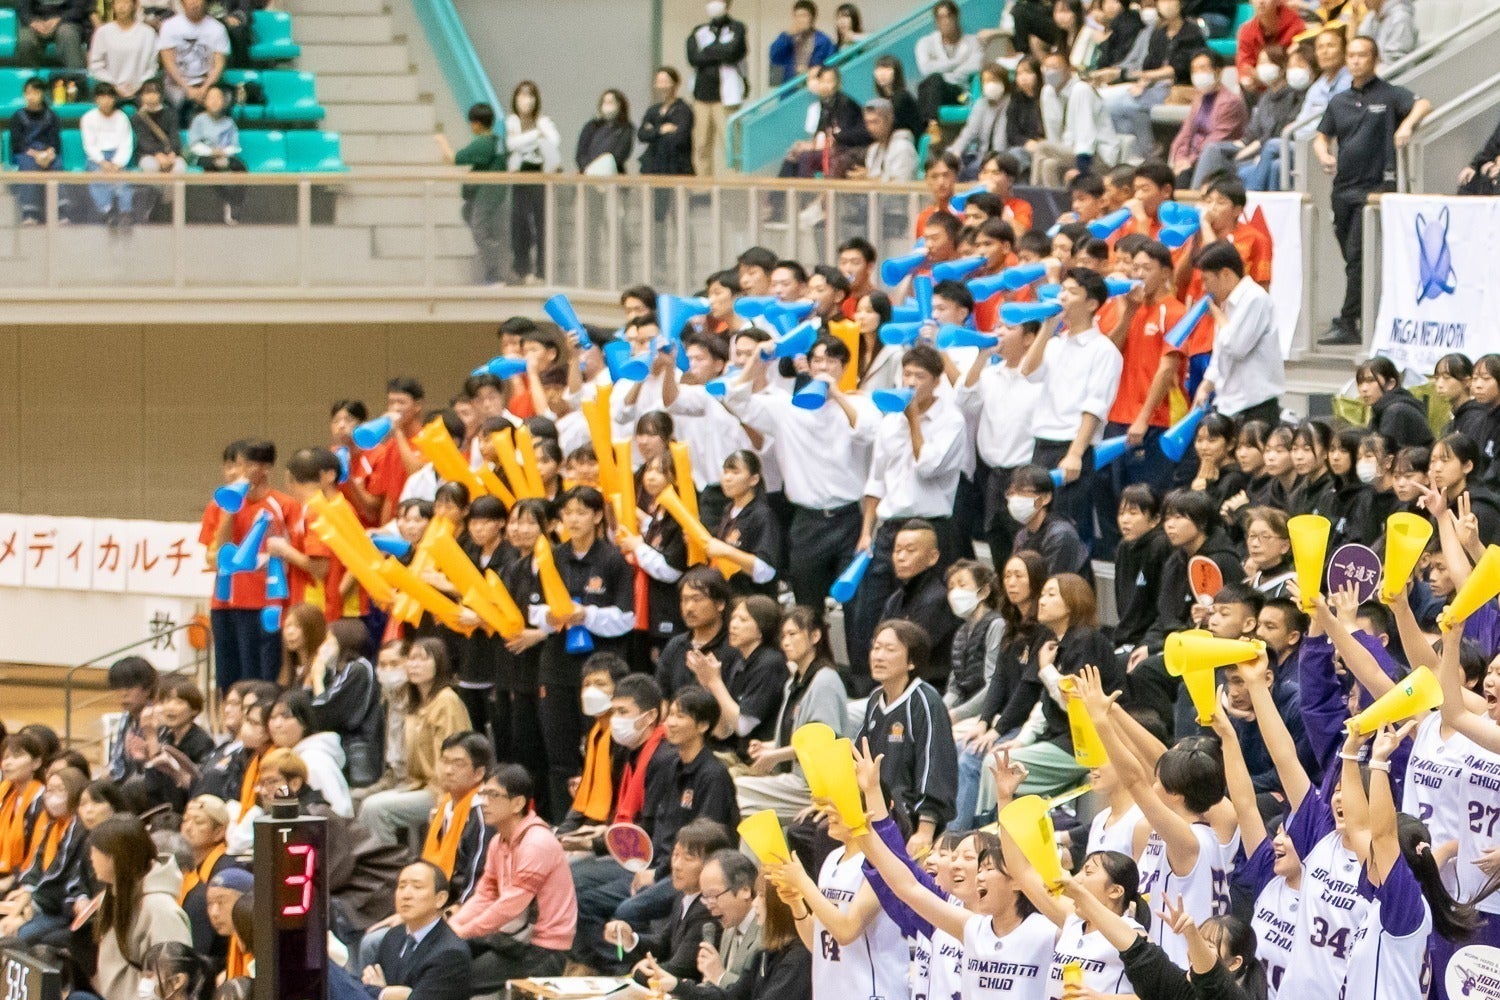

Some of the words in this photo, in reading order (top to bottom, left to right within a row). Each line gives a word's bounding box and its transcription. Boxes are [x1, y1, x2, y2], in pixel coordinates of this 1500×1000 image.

[1334, 561, 1377, 585] 一念通天
[1468, 800, 1500, 838] 27
[278, 828, 292, 843] T
[282, 845, 315, 915] 3
[1320, 889, 1356, 911] CHUO
[1310, 916, 1351, 960] 34
[968, 958, 1039, 978] YAMAGATA
[979, 976, 1014, 991] CHUO
